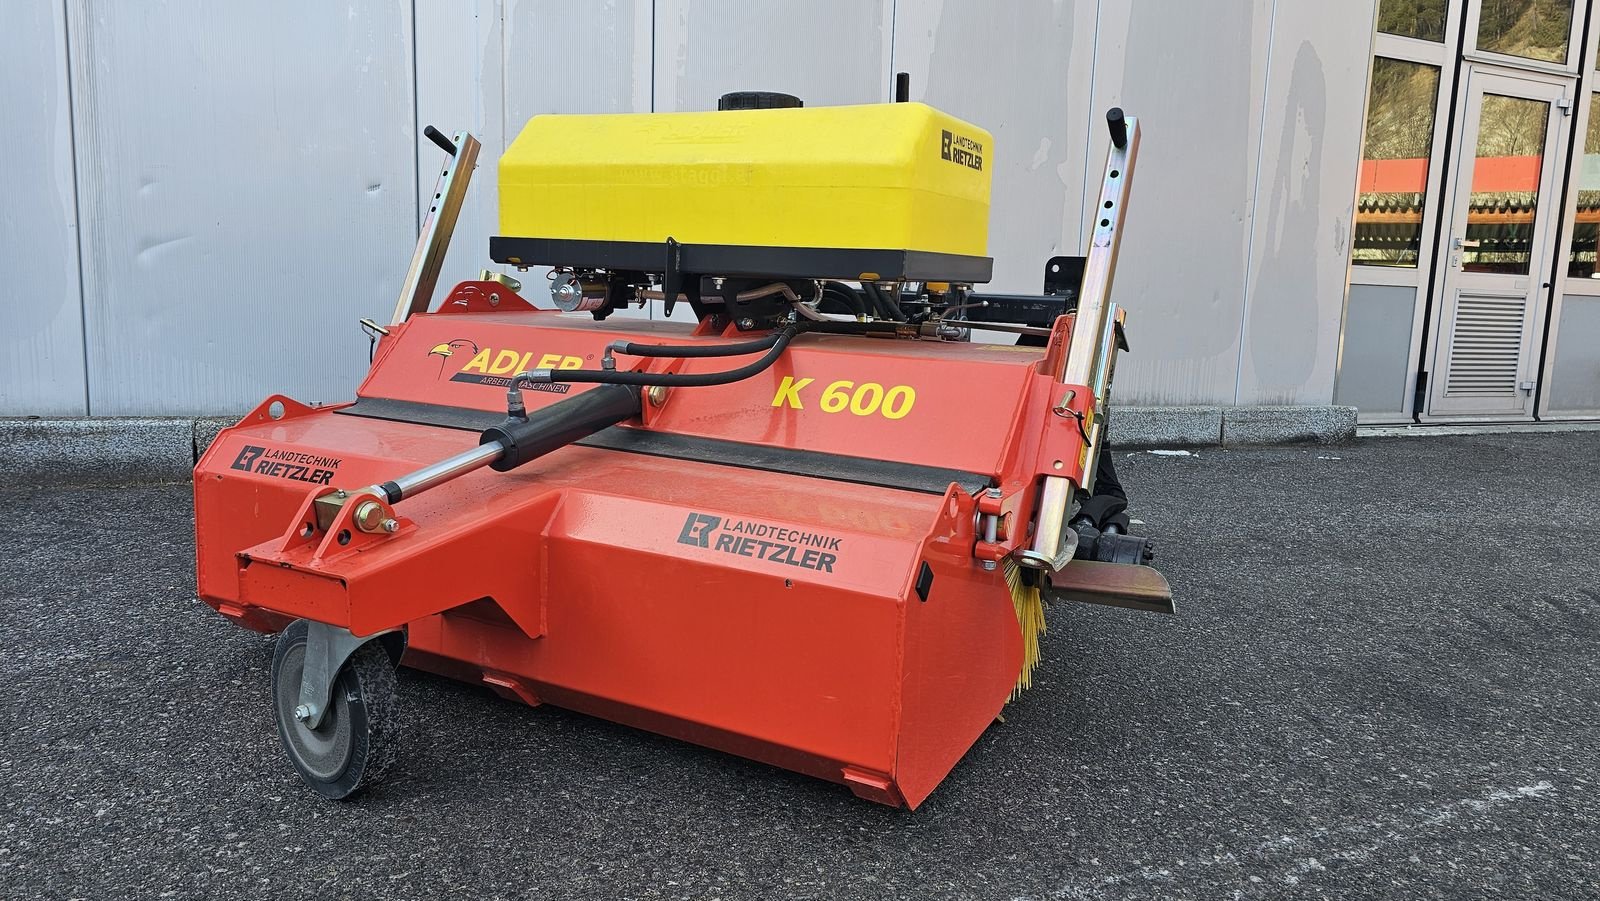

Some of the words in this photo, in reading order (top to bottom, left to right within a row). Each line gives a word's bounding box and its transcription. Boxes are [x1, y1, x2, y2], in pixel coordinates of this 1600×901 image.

[952, 133, 983, 154] LANDTECHNIK
[953, 147, 983, 171] RIETZLER
[771, 376, 816, 409] K
[819, 380, 916, 420] 600
[264, 448, 342, 469] LANDTECHNIK
[254, 459, 334, 485] RIETZLER
[723, 518, 842, 551] LANDTECHNIK
[714, 533, 837, 573] RIETZLER
